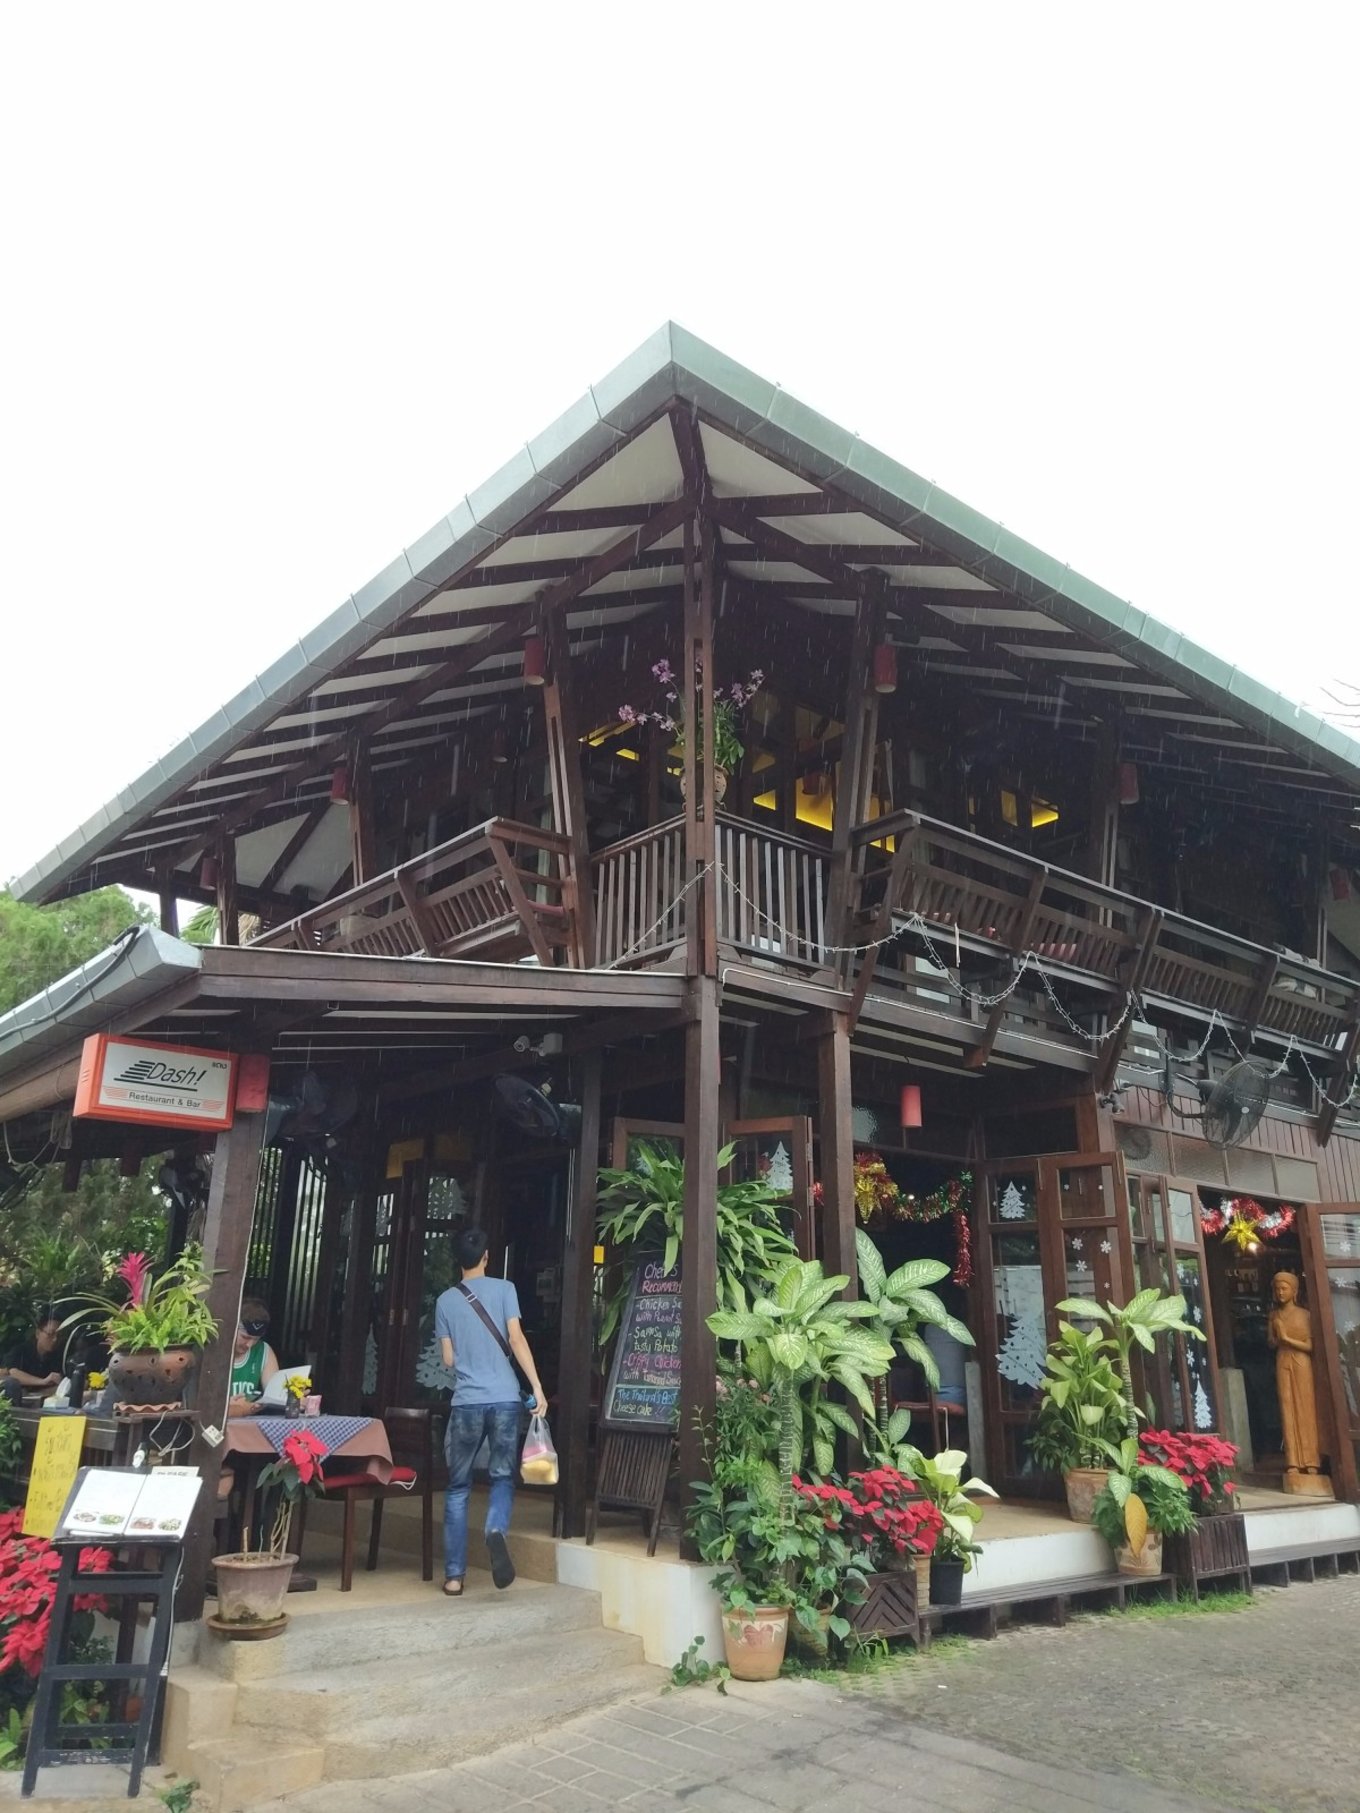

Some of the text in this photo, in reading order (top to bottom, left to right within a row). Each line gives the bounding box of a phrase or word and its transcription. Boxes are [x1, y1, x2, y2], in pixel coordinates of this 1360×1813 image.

[147, 1062, 207, 1086] Dash!
[129, 1091, 175, 1105] Restaurant
[186, 1100, 201, 1108] Bar
